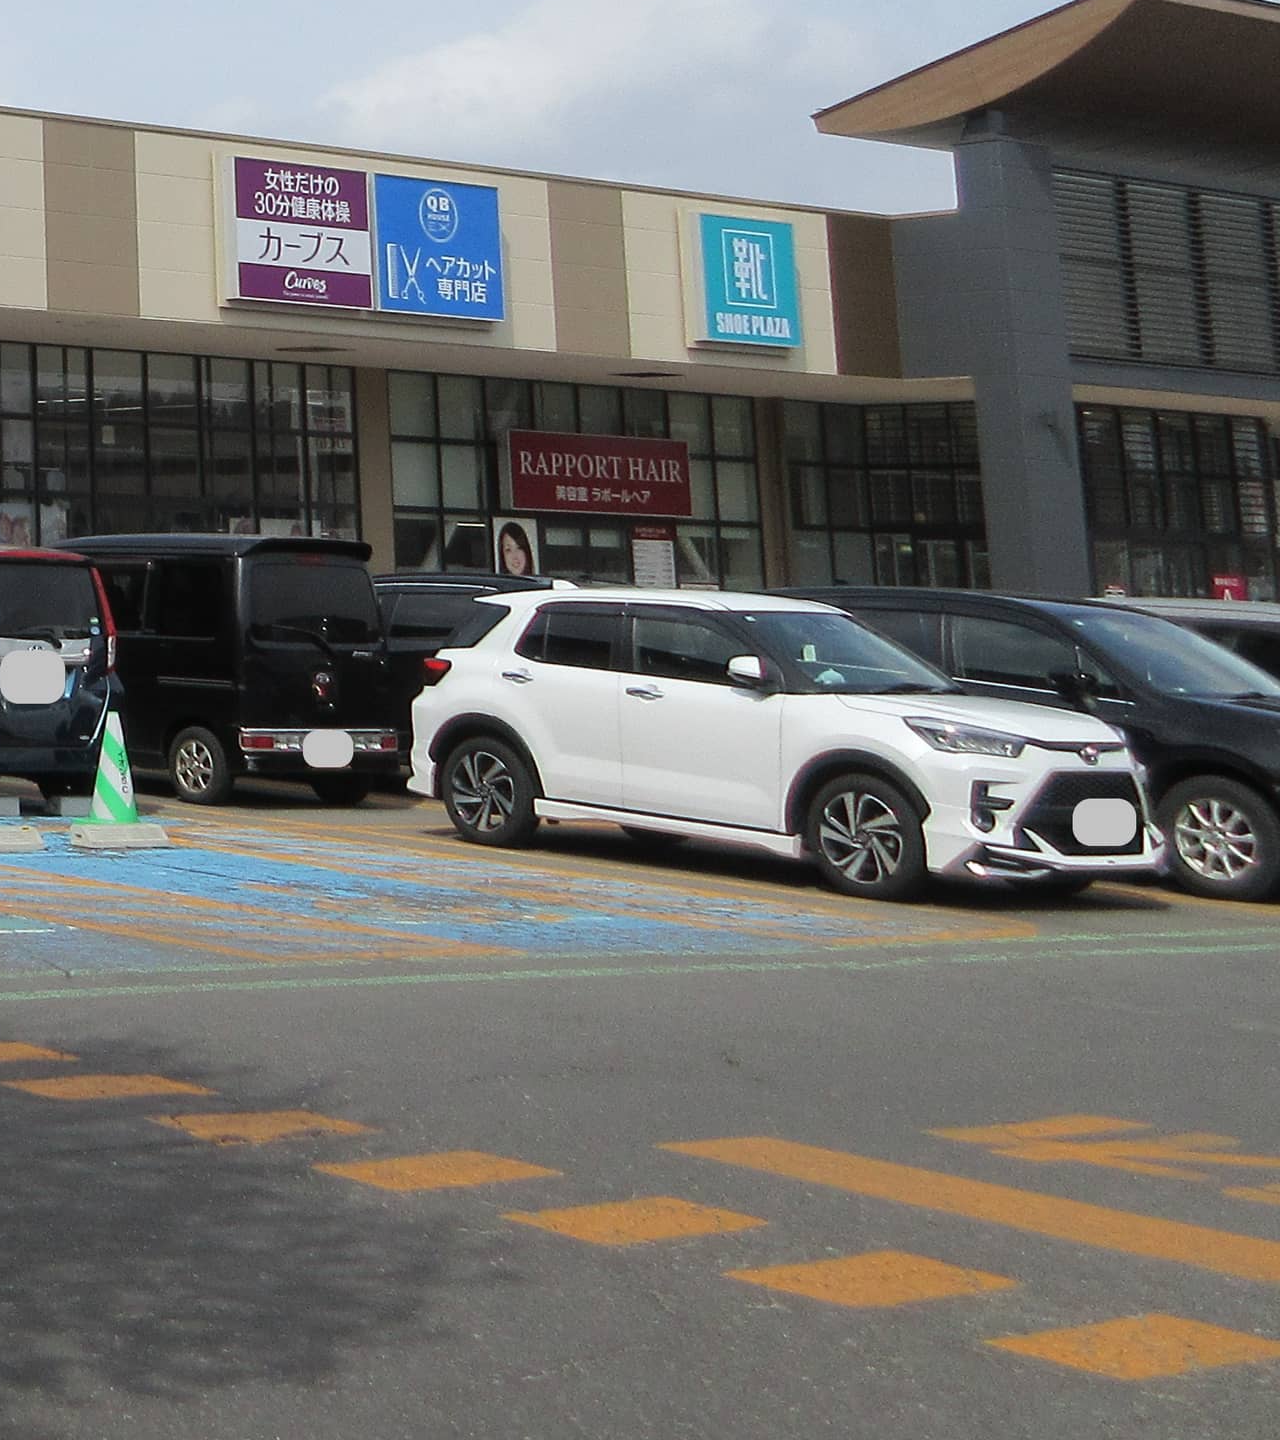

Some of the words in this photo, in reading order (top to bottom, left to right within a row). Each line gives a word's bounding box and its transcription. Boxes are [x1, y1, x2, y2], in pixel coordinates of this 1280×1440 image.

[264, 168, 339, 196] 女性だけの
[254, 192, 351, 224] 30分健康体操
[426, 194, 450, 212] QB
[258, 227, 350, 266] カーブス
[426, 256, 497, 281] ヘアカット
[284, 271, 327, 293] Curves
[437, 278, 487, 304] 専門店
[715, 312, 751, 336] SHOE
[752, 315, 791, 339] PLAZA
[519, 449, 621, 481] RAPPORT
[628, 457, 683, 483] HAIR
[555, 485, 588, 503] 美容室
